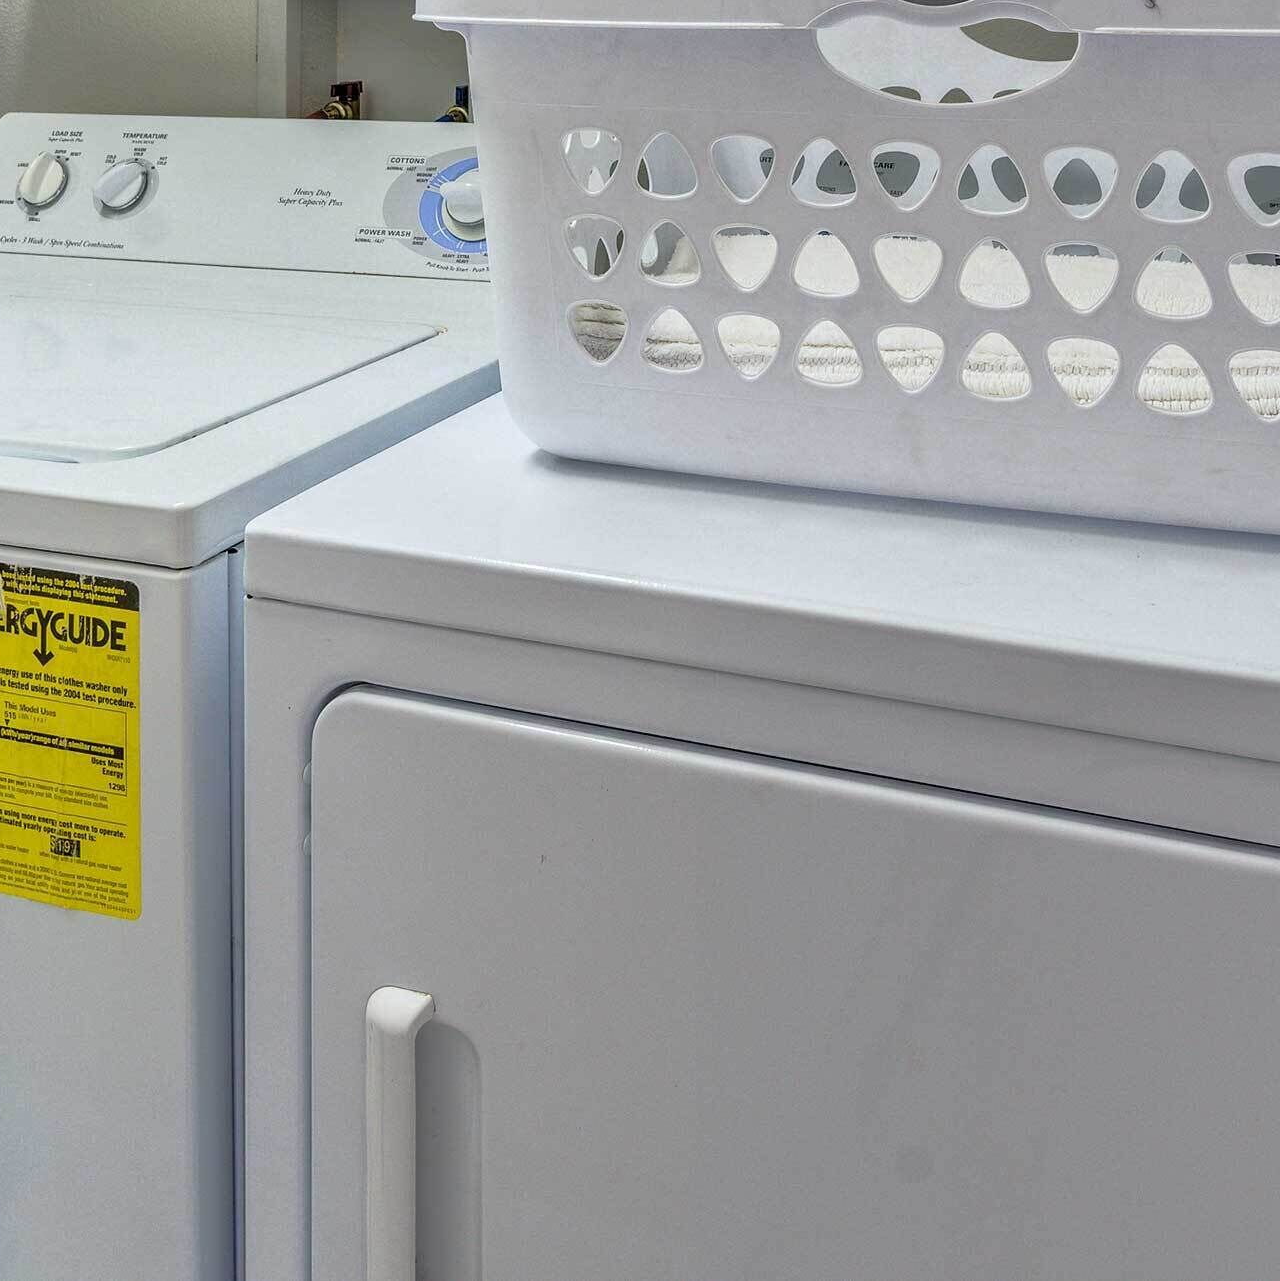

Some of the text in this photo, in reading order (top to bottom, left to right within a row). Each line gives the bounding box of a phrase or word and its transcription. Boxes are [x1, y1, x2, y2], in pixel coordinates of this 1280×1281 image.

[294, 188, 331, 198] Heavy Duty
[278, 197, 297, 206] Super
[298, 198, 326, 207] Capacity
[0, 236, 17, 244] Cycles
[64, 239, 82, 248] Speed
[83, 241, 124, 249] Combinations
[37, 575, 53, 586] using
[55, 577, 64, 585] the
[65, 579, 79, 588] 2004
[94, 585, 127, 597] procedure.
[21, 671, 33, 679] use
[35, 671, 43, 681] of
[44, 673, 56, 684] this
[58, 676, 83, 688] clothes
[85, 680, 110, 693] washer
[112, 685, 128, 697] only
[8, 679, 29, 691] tested
[31, 684, 49, 696] using
[51, 687, 62, 697] the
[63, 689, 81, 700] 2004
[82, 693, 96, 703] test
[98, 696, 137, 711] procedure.
[4, 710, 17, 719] 515
[5, 701, 57, 717] This Model Uses
[52, 737, 58, 745] of
[68, 740, 90, 751] similar
[91, 744, 114, 756] models
[91, 756, 123, 770] Uses Most
[102, 767, 124, 779] Energy
[4, 808, 20, 819] using
[21, 812, 37, 822] more
[38, 815, 57, 827] energy
[59, 819, 73, 829] cost
[74, 822, 90, 832] more
[91, 825, 98, 833] to
[99, 827, 126, 840] operate.
[24, 821, 42, 832] yearly
[43, 824, 71, 838] operating
[73, 831, 87, 840] cost
[89, 833, 97, 842] is:
